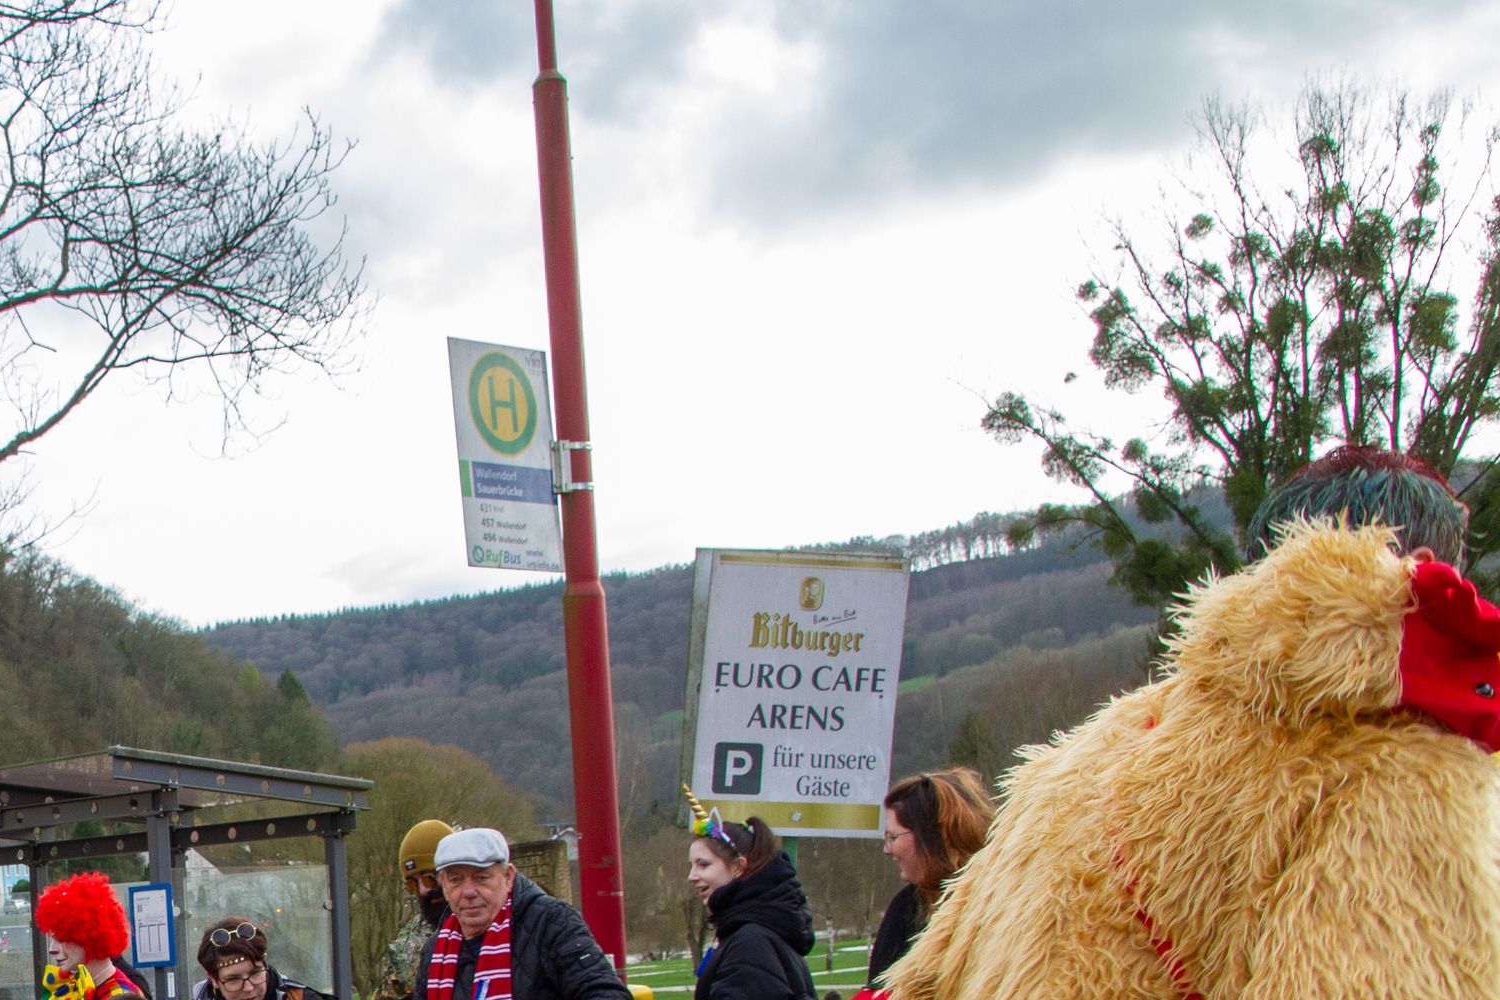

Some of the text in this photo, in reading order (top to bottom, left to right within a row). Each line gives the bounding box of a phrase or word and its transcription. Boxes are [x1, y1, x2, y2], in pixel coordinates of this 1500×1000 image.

[488, 375, 518, 432] H
[475, 467, 517, 480] Wallendorf
[485, 549, 521, 566] RufBus
[748, 612, 864, 657] Bitburger
[715, 662, 886, 693] EURO CAFE
[747, 703, 845, 732] ARENS
[725, 750, 753, 787] P
[772, 745, 877, 770] für unsere
[796, 775, 850, 797] Gäste
